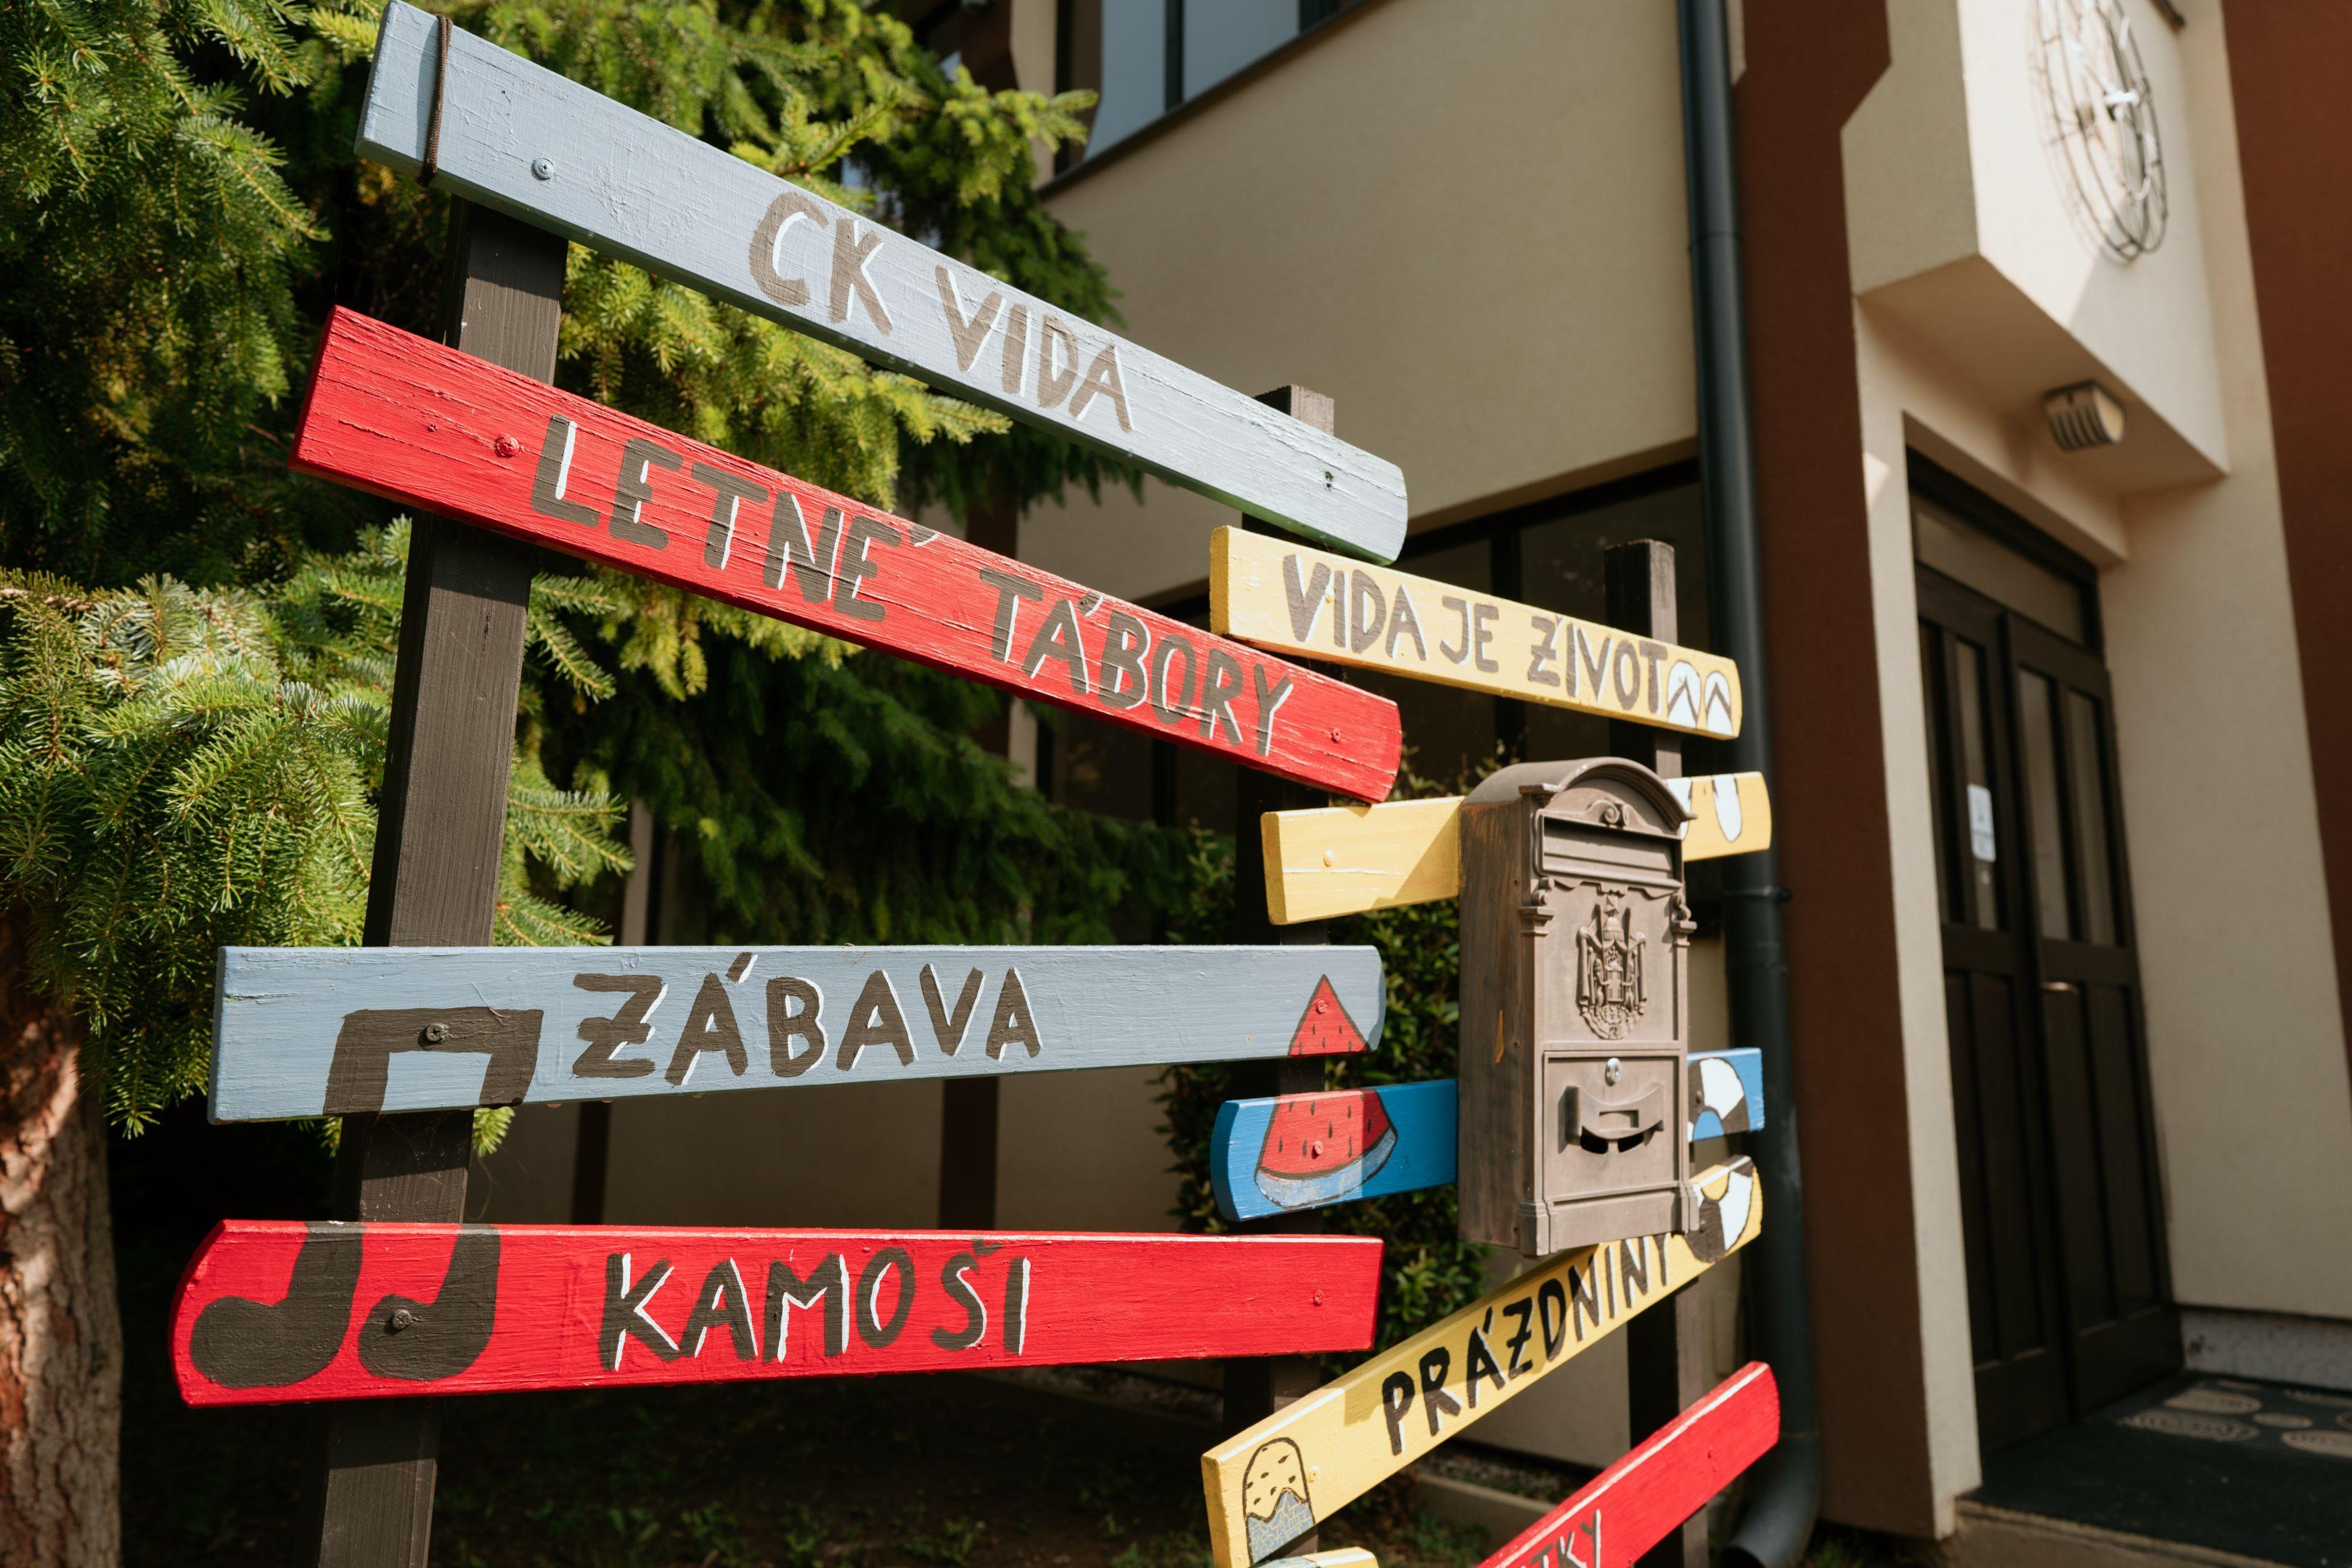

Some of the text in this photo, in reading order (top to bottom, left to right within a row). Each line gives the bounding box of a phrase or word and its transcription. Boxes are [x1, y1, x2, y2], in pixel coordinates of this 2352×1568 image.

[748, 192, 1134, 433] CK VIDA
[531, 414, 1294, 756] LETNÉ TÁBORY
[1283, 554, 1667, 717] VIDA JE ŽIVOT
[571, 952, 1043, 1086] ZÁBAVA
[598, 1236, 1031, 1372] KAMOŠI
